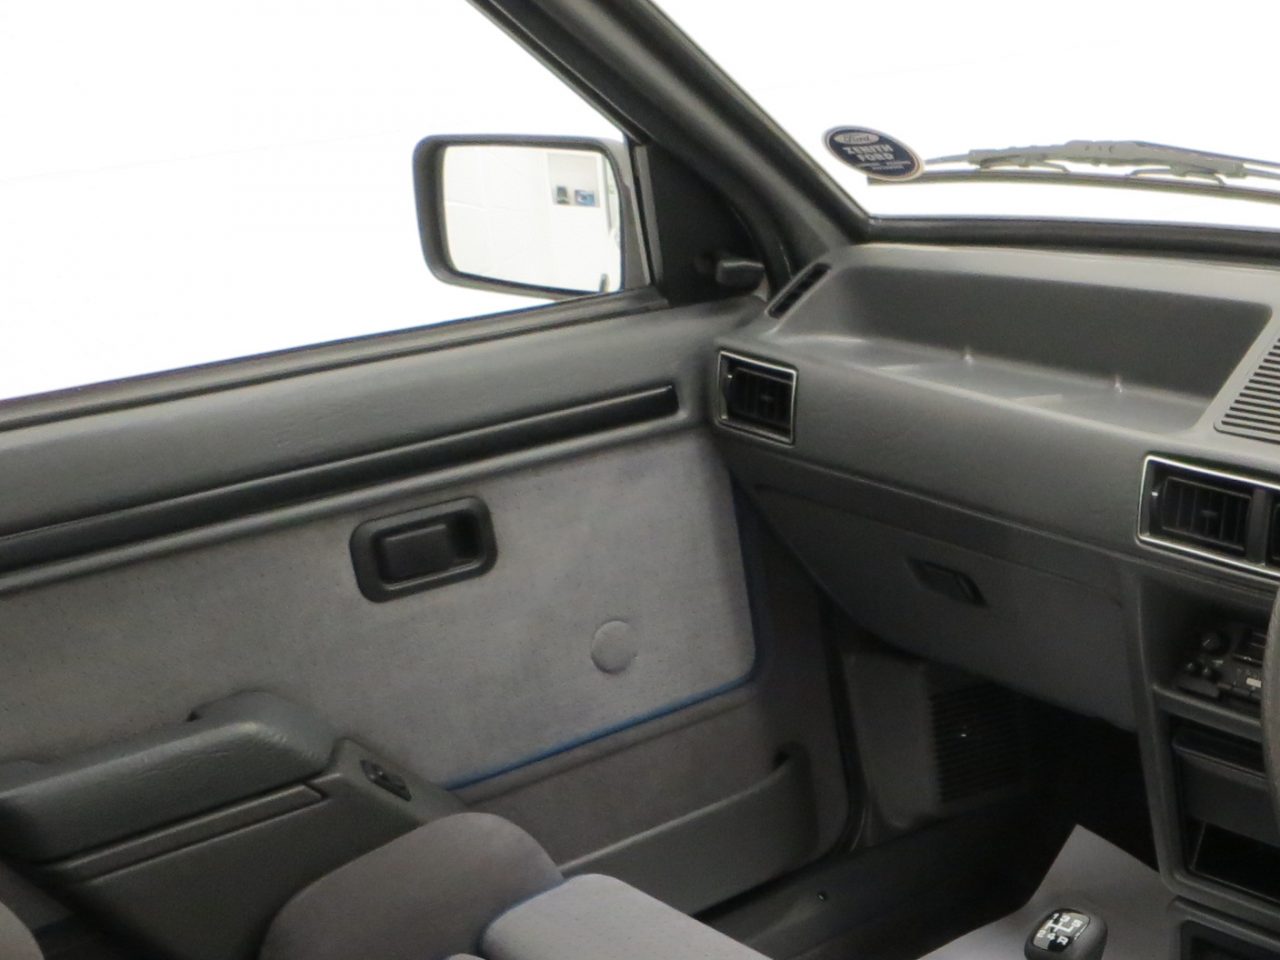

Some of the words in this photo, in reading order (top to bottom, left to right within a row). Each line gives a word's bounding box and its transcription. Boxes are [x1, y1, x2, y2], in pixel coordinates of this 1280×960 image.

[842, 144, 893, 154] ZENITH
[857, 153, 894, 161] FORD
[1056, 935, 1069, 946] R
